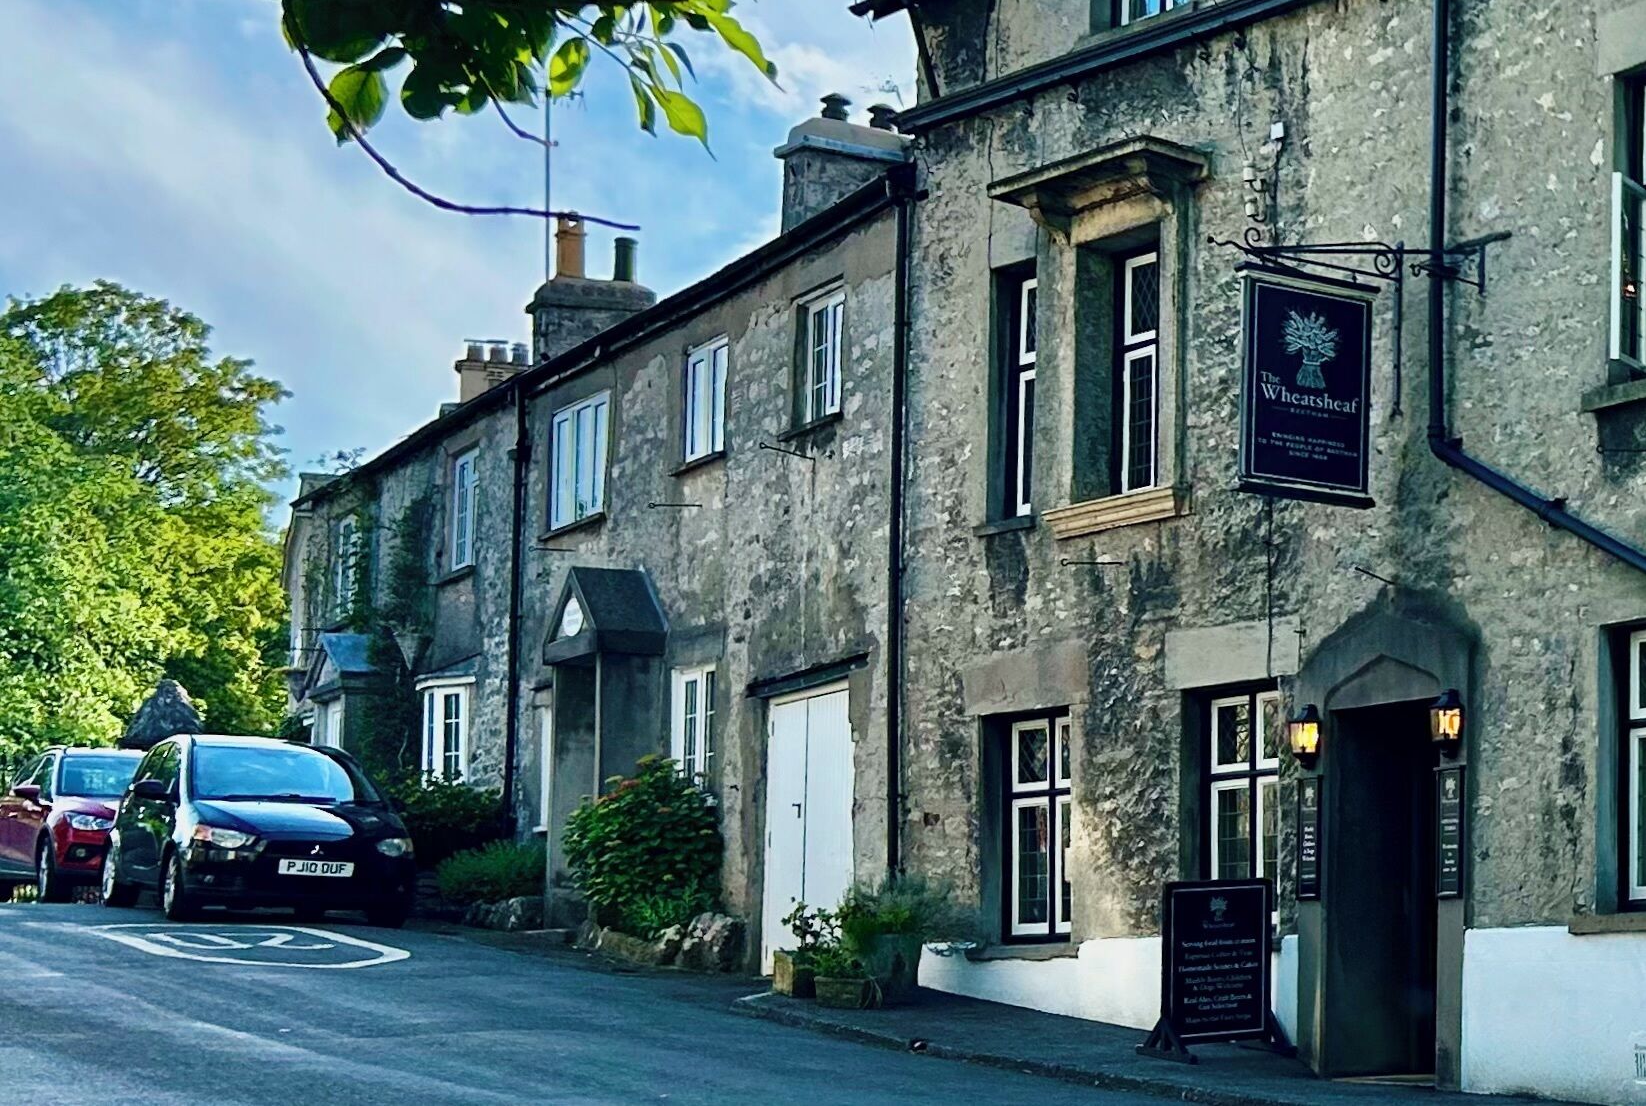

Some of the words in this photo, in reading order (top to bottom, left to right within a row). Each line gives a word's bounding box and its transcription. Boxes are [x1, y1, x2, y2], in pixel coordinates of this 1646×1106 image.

[1260, 371, 1281, 384] The
[1260, 382, 1360, 414] Wheatsheaf
[287, 861, 318, 873] PJ10
